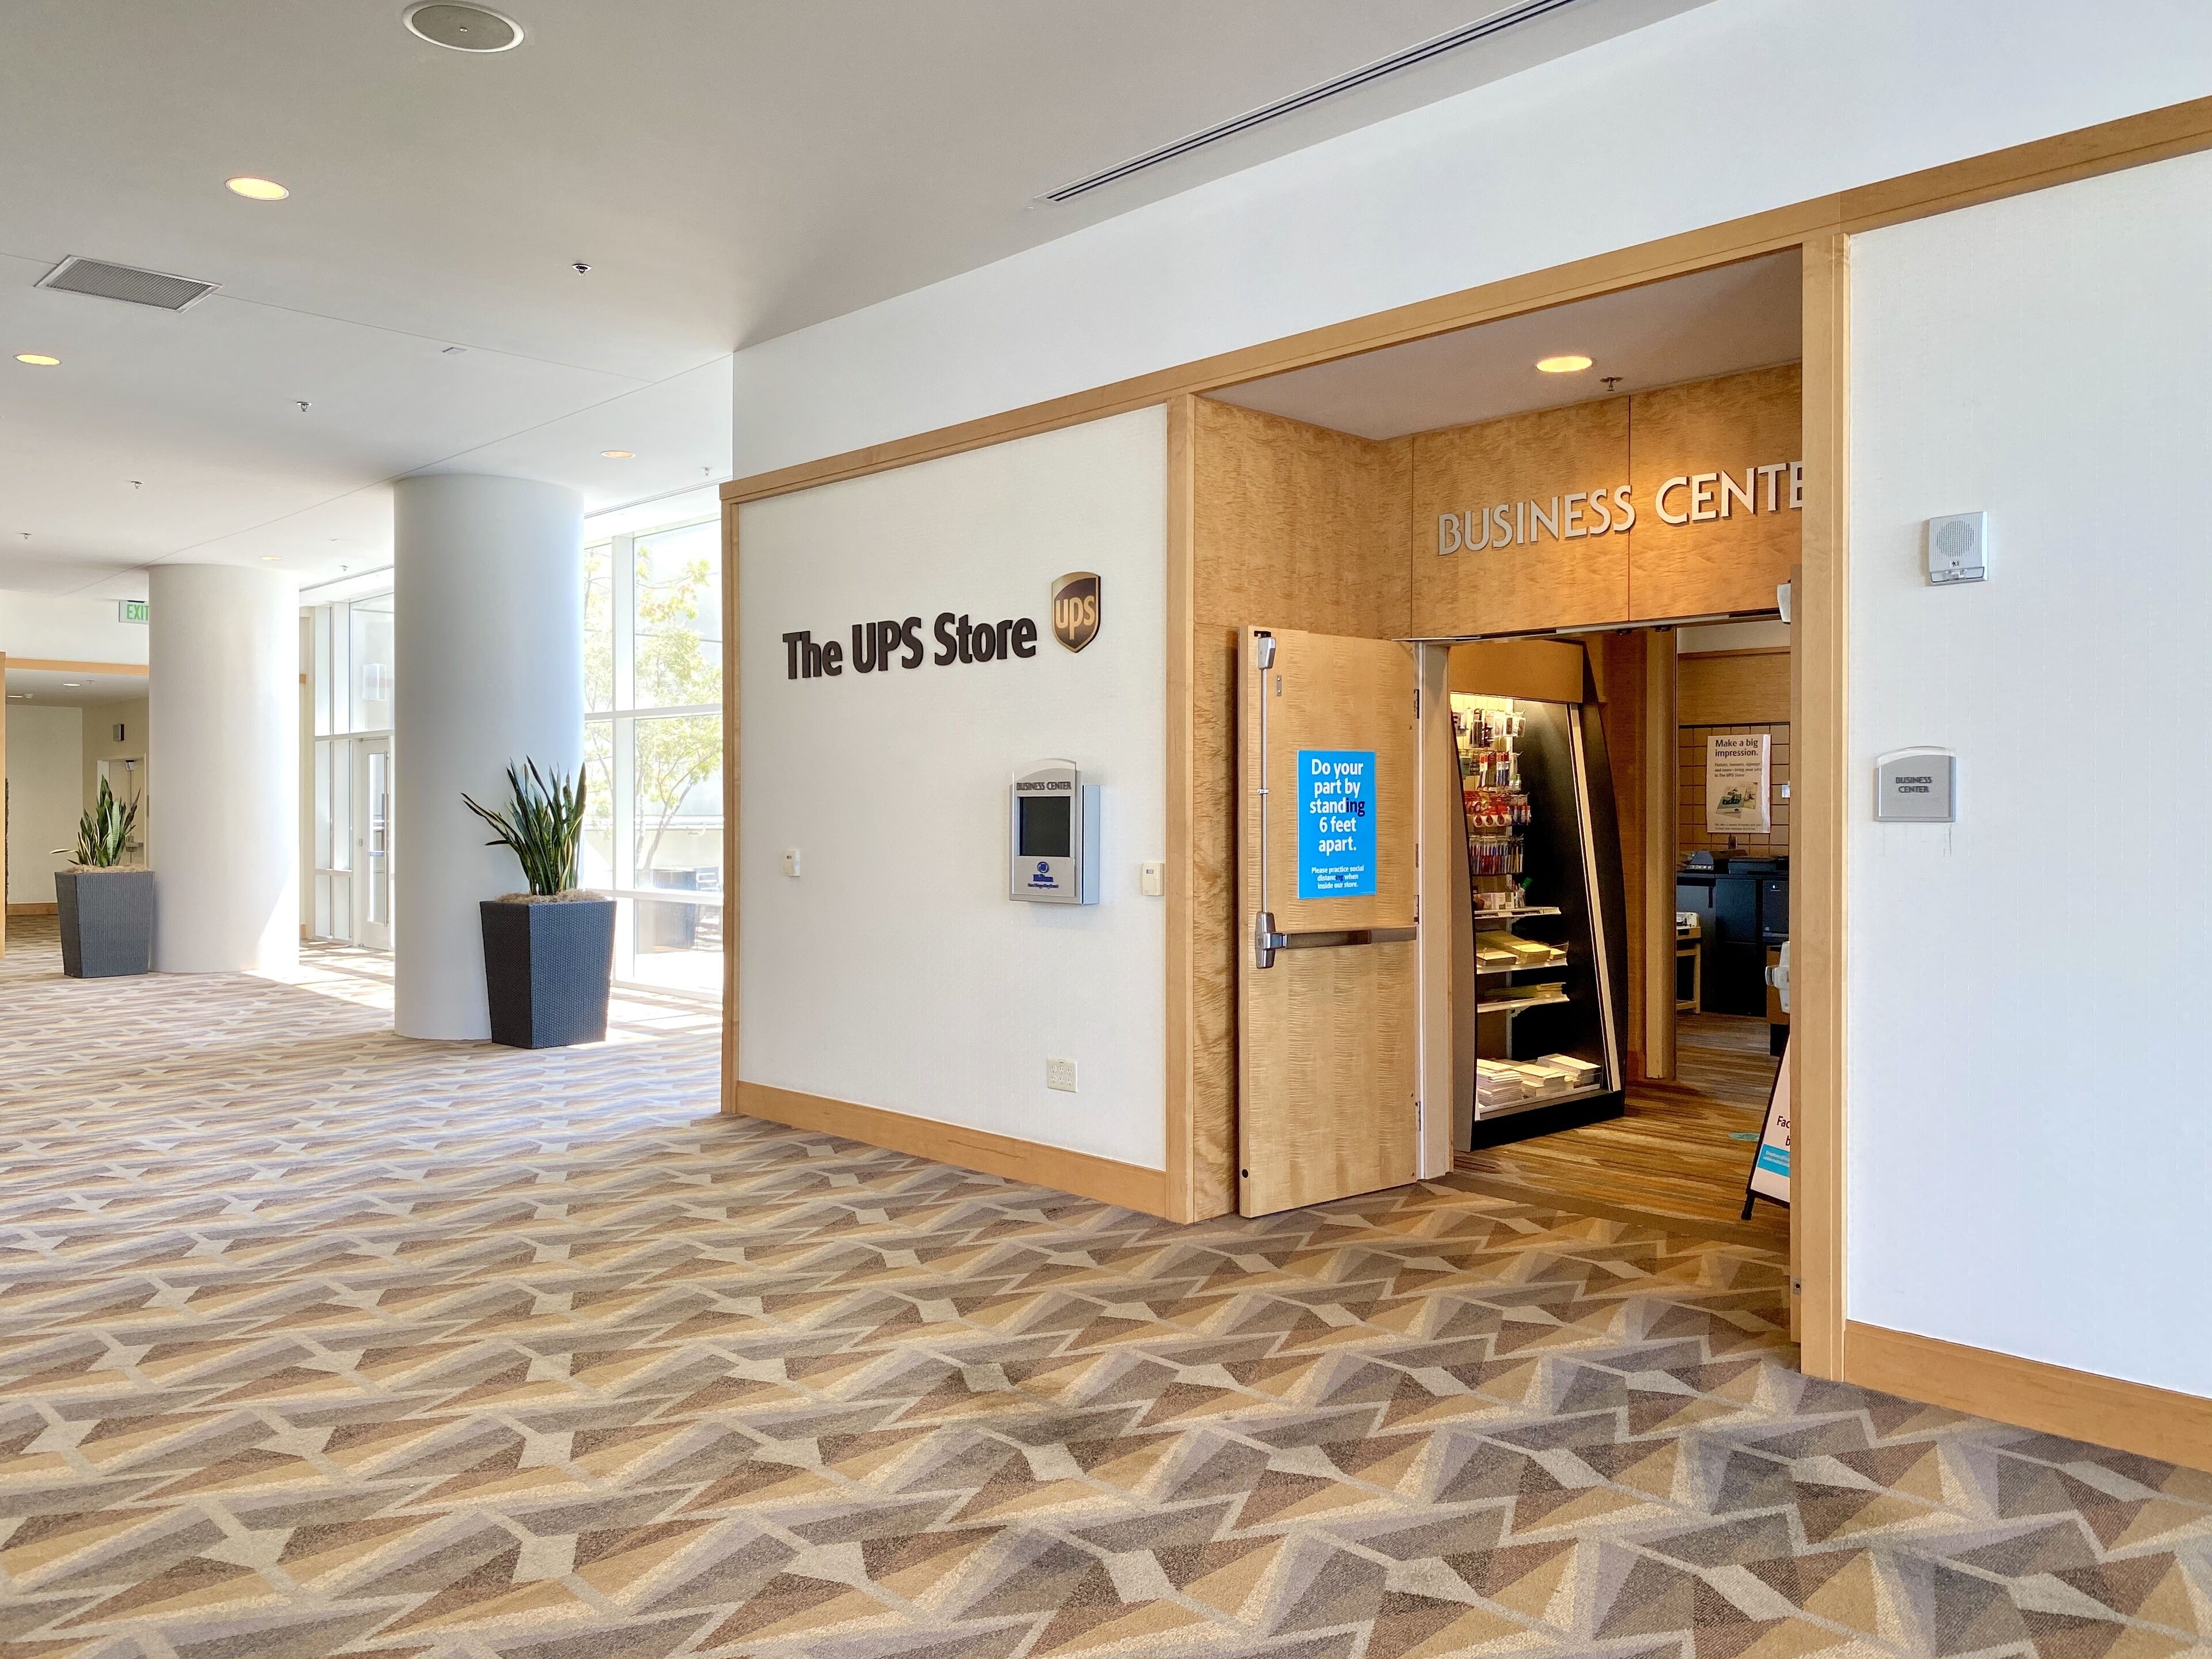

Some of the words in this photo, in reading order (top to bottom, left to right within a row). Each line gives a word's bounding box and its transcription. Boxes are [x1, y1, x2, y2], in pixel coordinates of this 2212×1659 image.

[1438, 484, 1636, 555] BUSINESS
[127, 604, 149, 621] EXIT
[1055, 595, 1095, 641] ups
[782, 630, 843, 680] The
[852, 616, 924, 673] UPS
[934, 612, 1037, 666] Store
[1715, 739, 1737, 747] Make
[1746, 738, 1759, 748] big
[1715, 749, 1759, 759] impression.
[1311, 759, 1331, 775] Do
[1334, 762, 1364, 779] your
[1016, 782, 1046, 790] BUSINESS
[1046, 781, 1072, 790] CENTER
[1314, 779, 1342, 798] part
[1344, 778, 1361, 798] by
[1309, 796, 1365, 817] standing
[1319, 816, 1328, 833] 6
[1330, 816, 1357, 833] feet
[1319, 836, 1357, 857] apart.
[1329, 866, 1349, 874] practice
